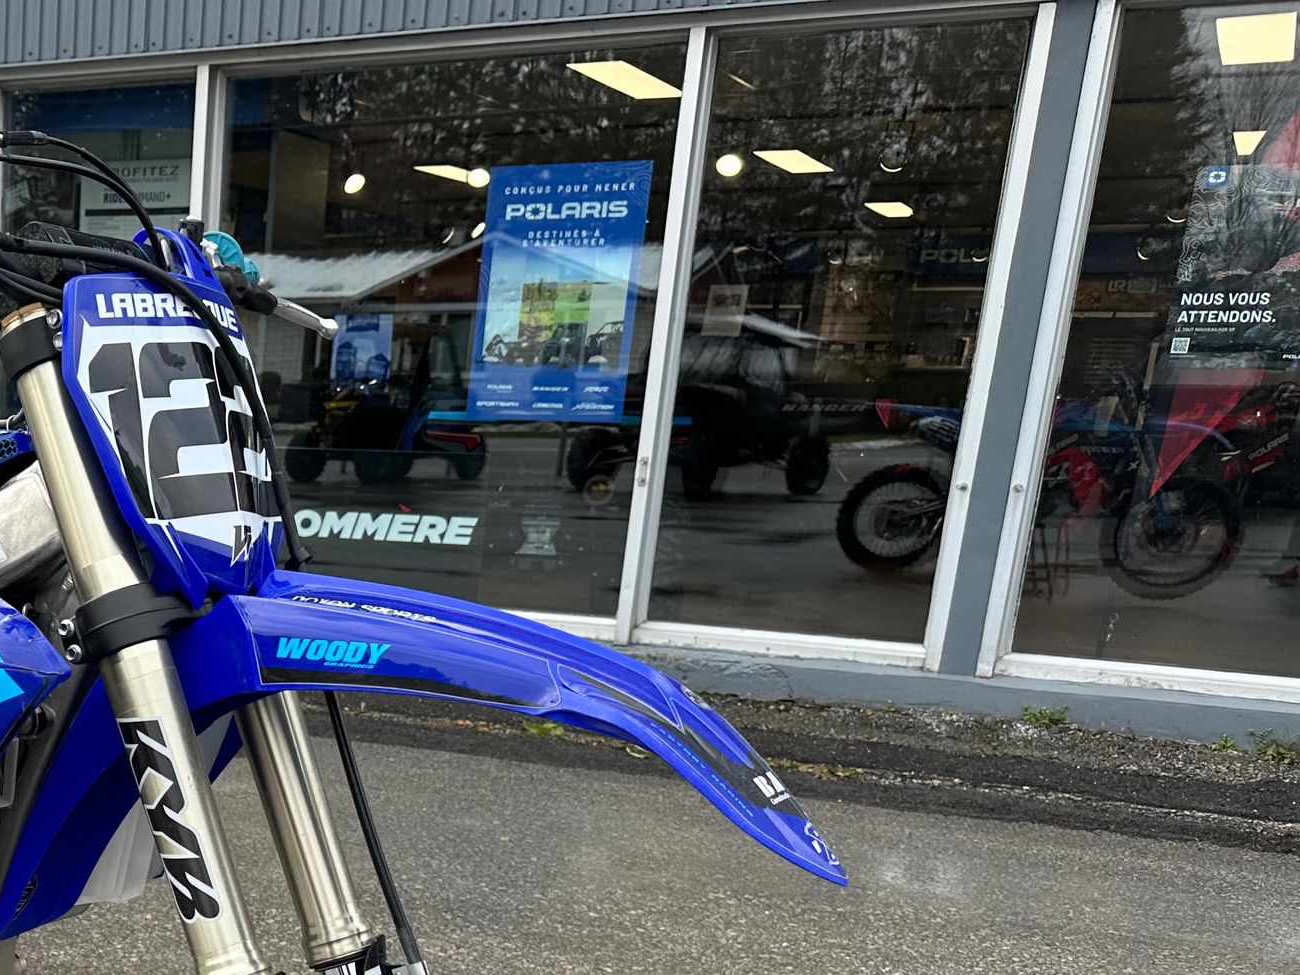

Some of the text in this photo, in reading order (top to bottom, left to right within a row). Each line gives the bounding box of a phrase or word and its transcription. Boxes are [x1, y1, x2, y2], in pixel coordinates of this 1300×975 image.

[505, 182, 636, 197] CONÇUS POUR MENER
[505, 200, 628, 221] POLARIS
[1181, 292, 1271, 306] NOUS VOUS
[1177, 310, 1276, 323] ATTENDONS.
[89, 342, 282, 520] 122
[296, 503, 478, 546] OMMÈRE
[276, 637, 391, 665] WOODY
[650, 722, 754, 817] FACTORY RACING
[116, 716, 221, 924] KYB
